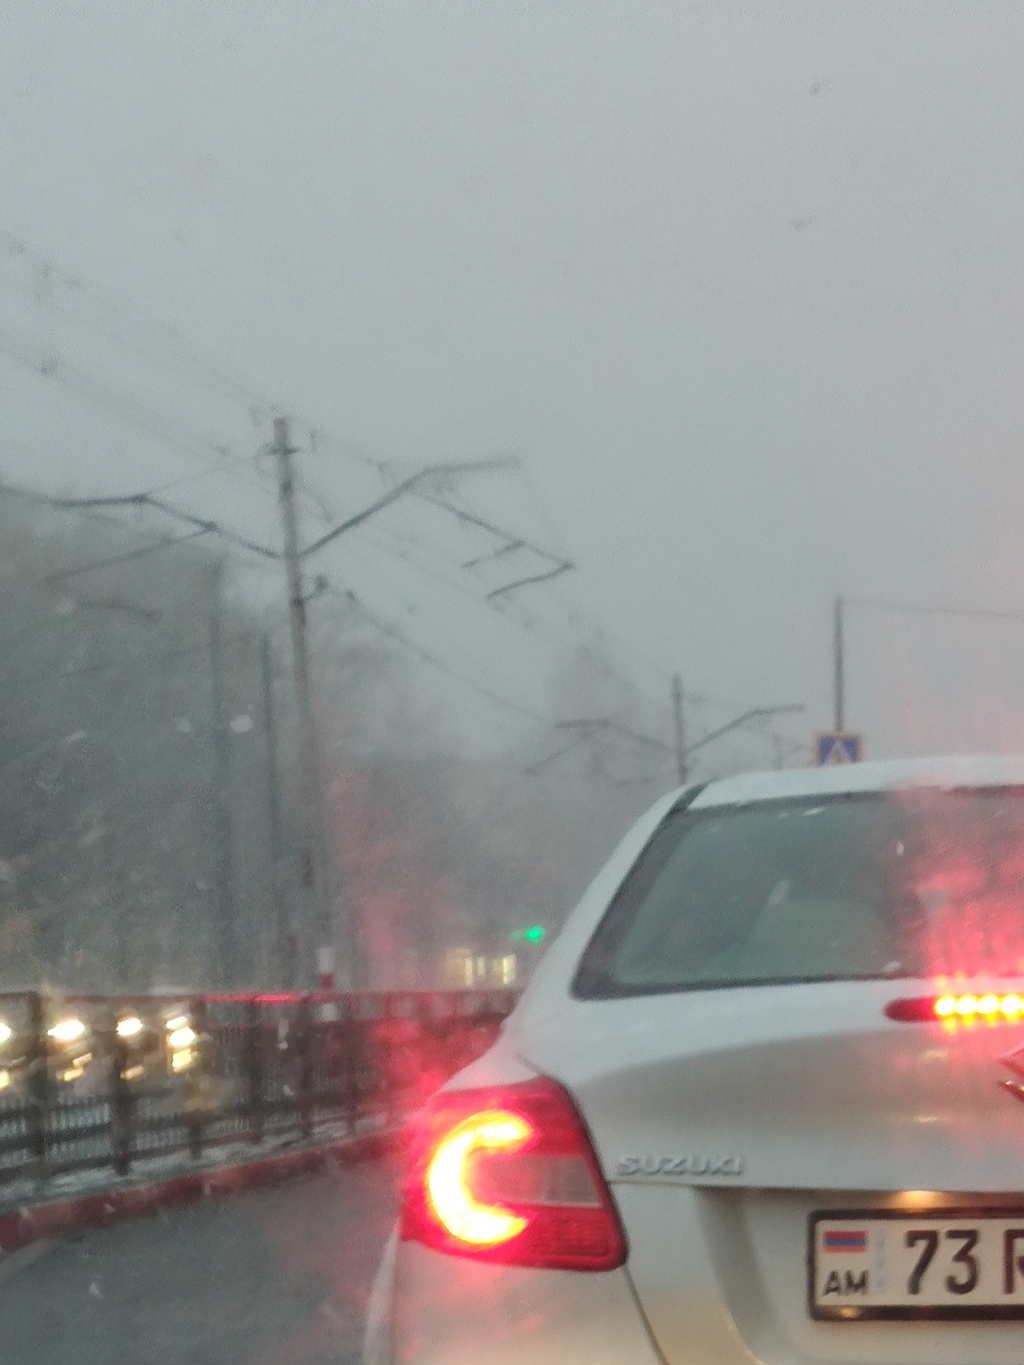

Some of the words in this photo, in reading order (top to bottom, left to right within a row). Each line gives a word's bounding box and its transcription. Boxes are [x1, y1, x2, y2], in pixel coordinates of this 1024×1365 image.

[617, 1155, 742, 1176] SUZUKI
[905, 1228, 979, 1296] 73
[822, 1268, 868, 1297] AM
